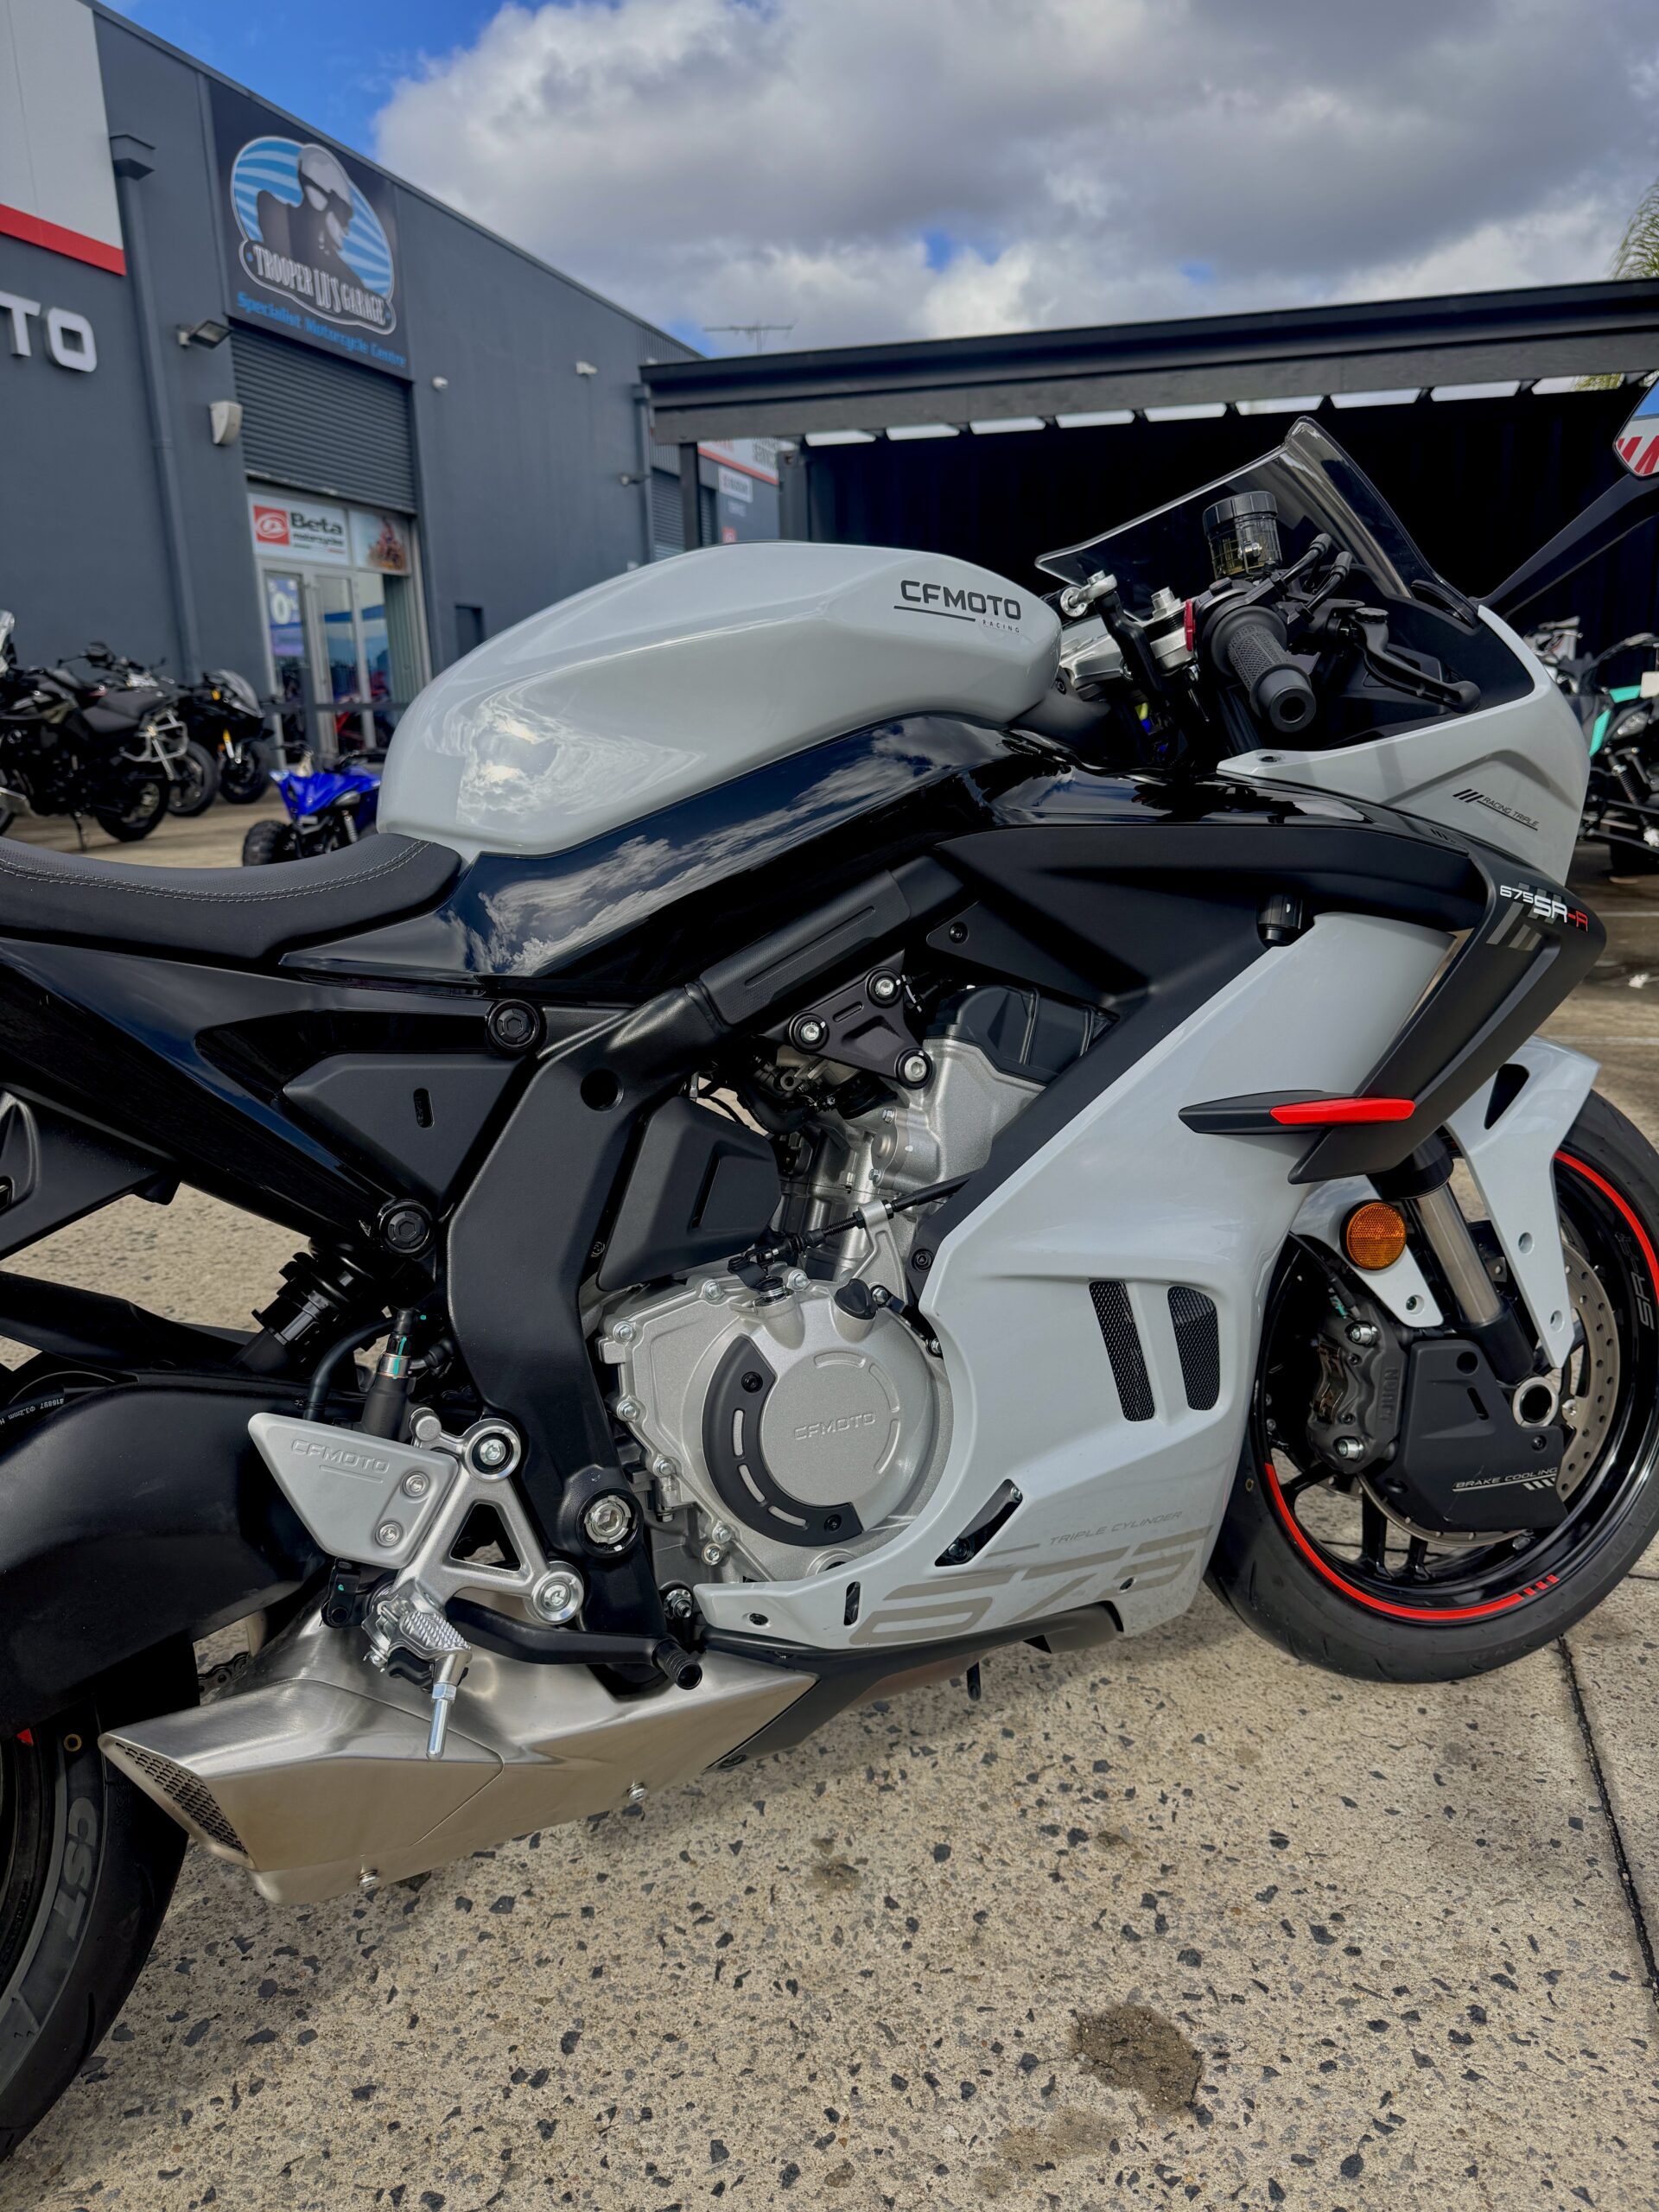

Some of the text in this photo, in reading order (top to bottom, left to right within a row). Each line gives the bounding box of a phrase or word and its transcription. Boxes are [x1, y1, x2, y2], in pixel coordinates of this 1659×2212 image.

[252, 245, 314, 297] TROOPER
[340, 283, 386, 326] GARAGE
[237, 290, 302, 329] Specialist
[303, 316, 370, 353] Motorcycle
[291, 512, 342, 535] Beta
[900, 580, 1021, 620] CFMOTO
[982, 619, 1020, 633] RACING
[1482, 796, 1540, 827] RACING TRIPLE
[794, 1412, 876, 1440] CFMOTO
[291, 1440, 390, 1473] CFMOTO
[1455, 1467, 1559, 1489] BRAKE COOLING
[1049, 1510, 1184, 1547] TRIPLE CYLINDER
[54, 1796, 98, 1942] CST
